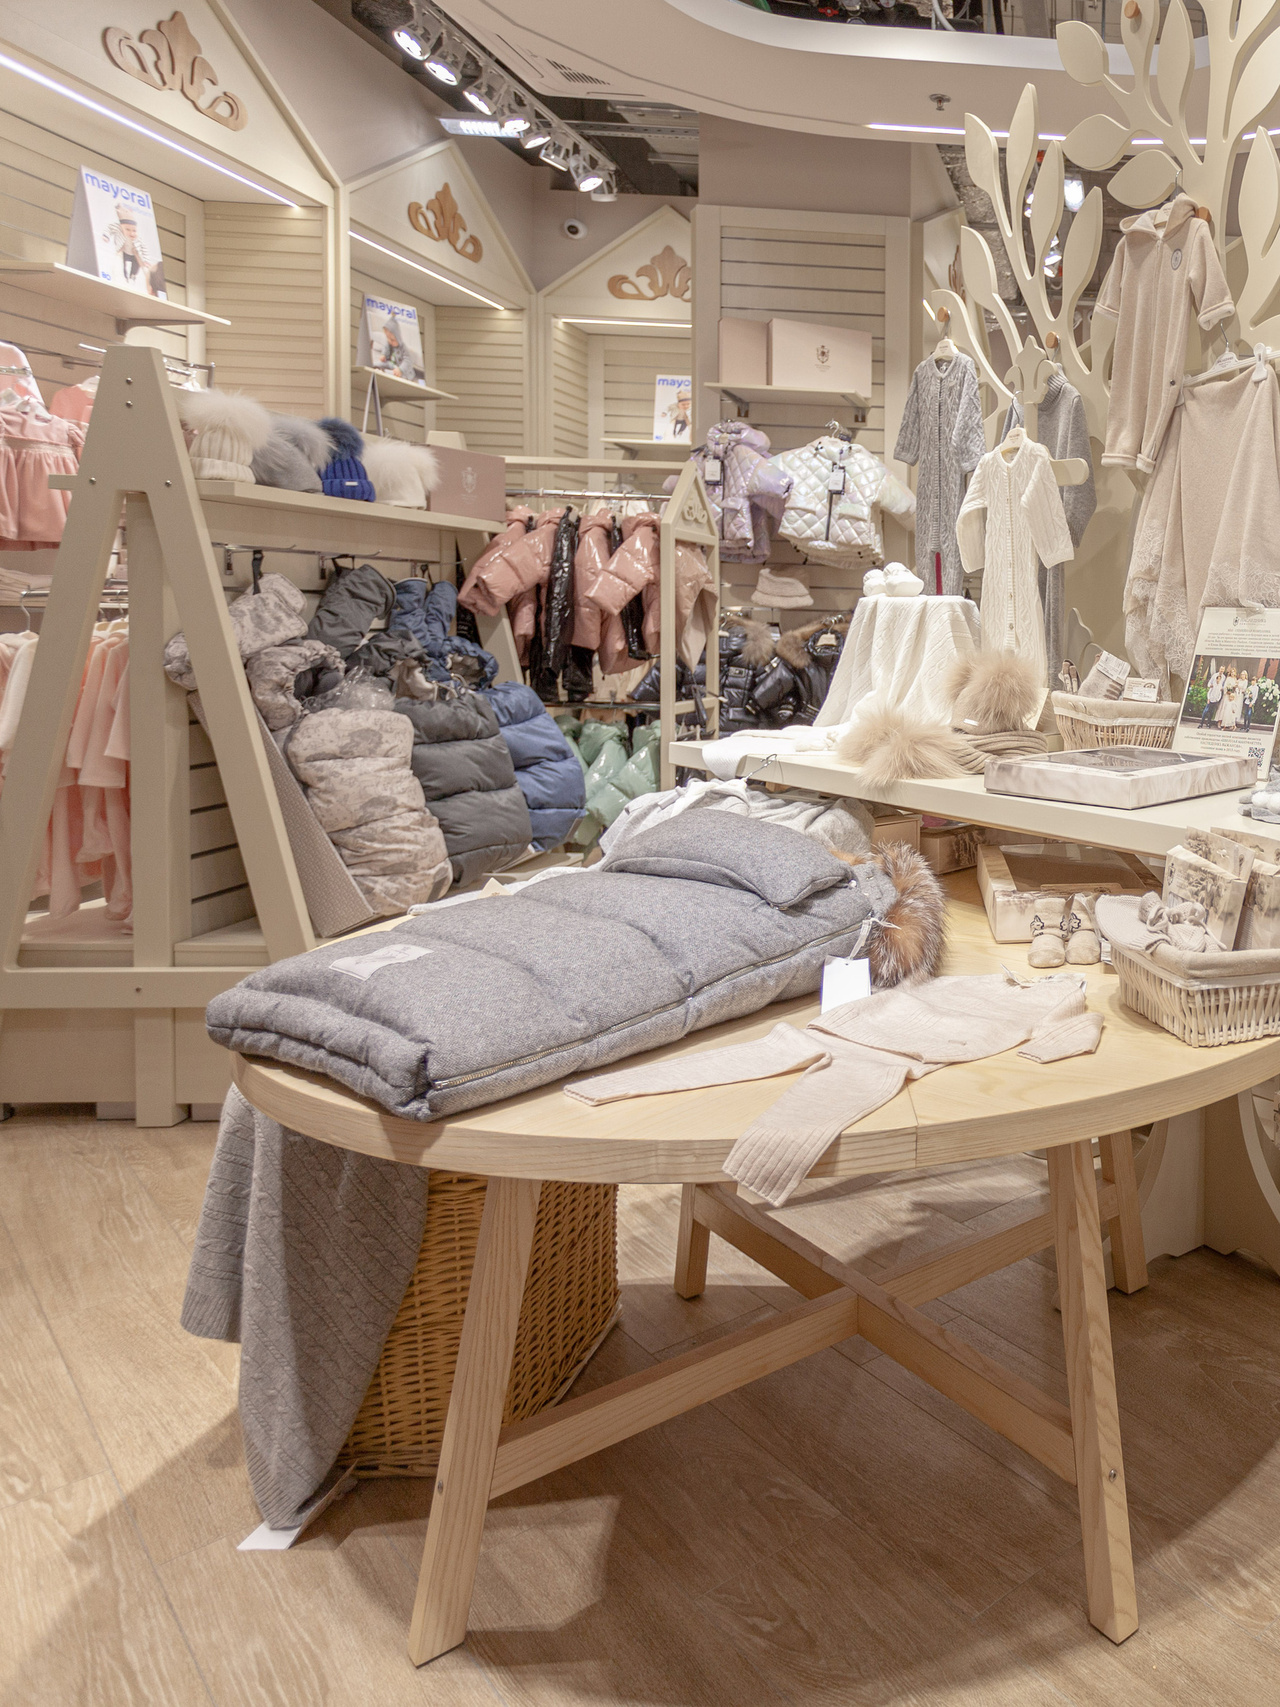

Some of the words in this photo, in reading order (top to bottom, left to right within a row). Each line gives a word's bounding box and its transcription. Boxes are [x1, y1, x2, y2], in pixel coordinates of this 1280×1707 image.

[85, 172, 151, 209] mayoral
[365, 298, 417, 320] mayoral
[657, 378, 691, 389] mayo
